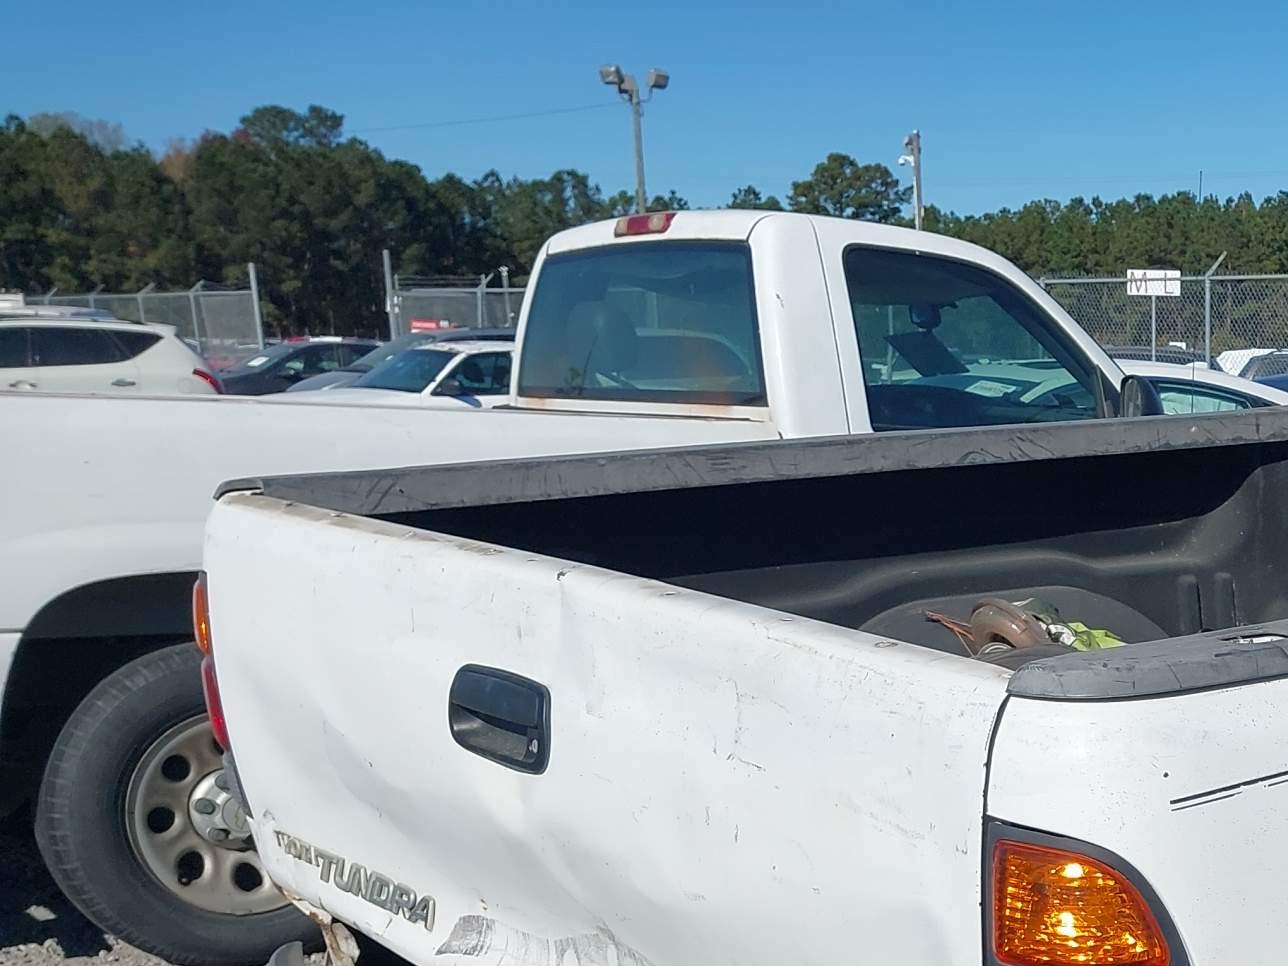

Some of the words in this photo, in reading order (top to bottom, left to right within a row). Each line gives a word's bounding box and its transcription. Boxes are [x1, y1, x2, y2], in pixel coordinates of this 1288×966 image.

[1129, 270, 1149, 294] M
[1163, 271, 1175, 295] L
[317, 850, 437, 933] TUNDRA
